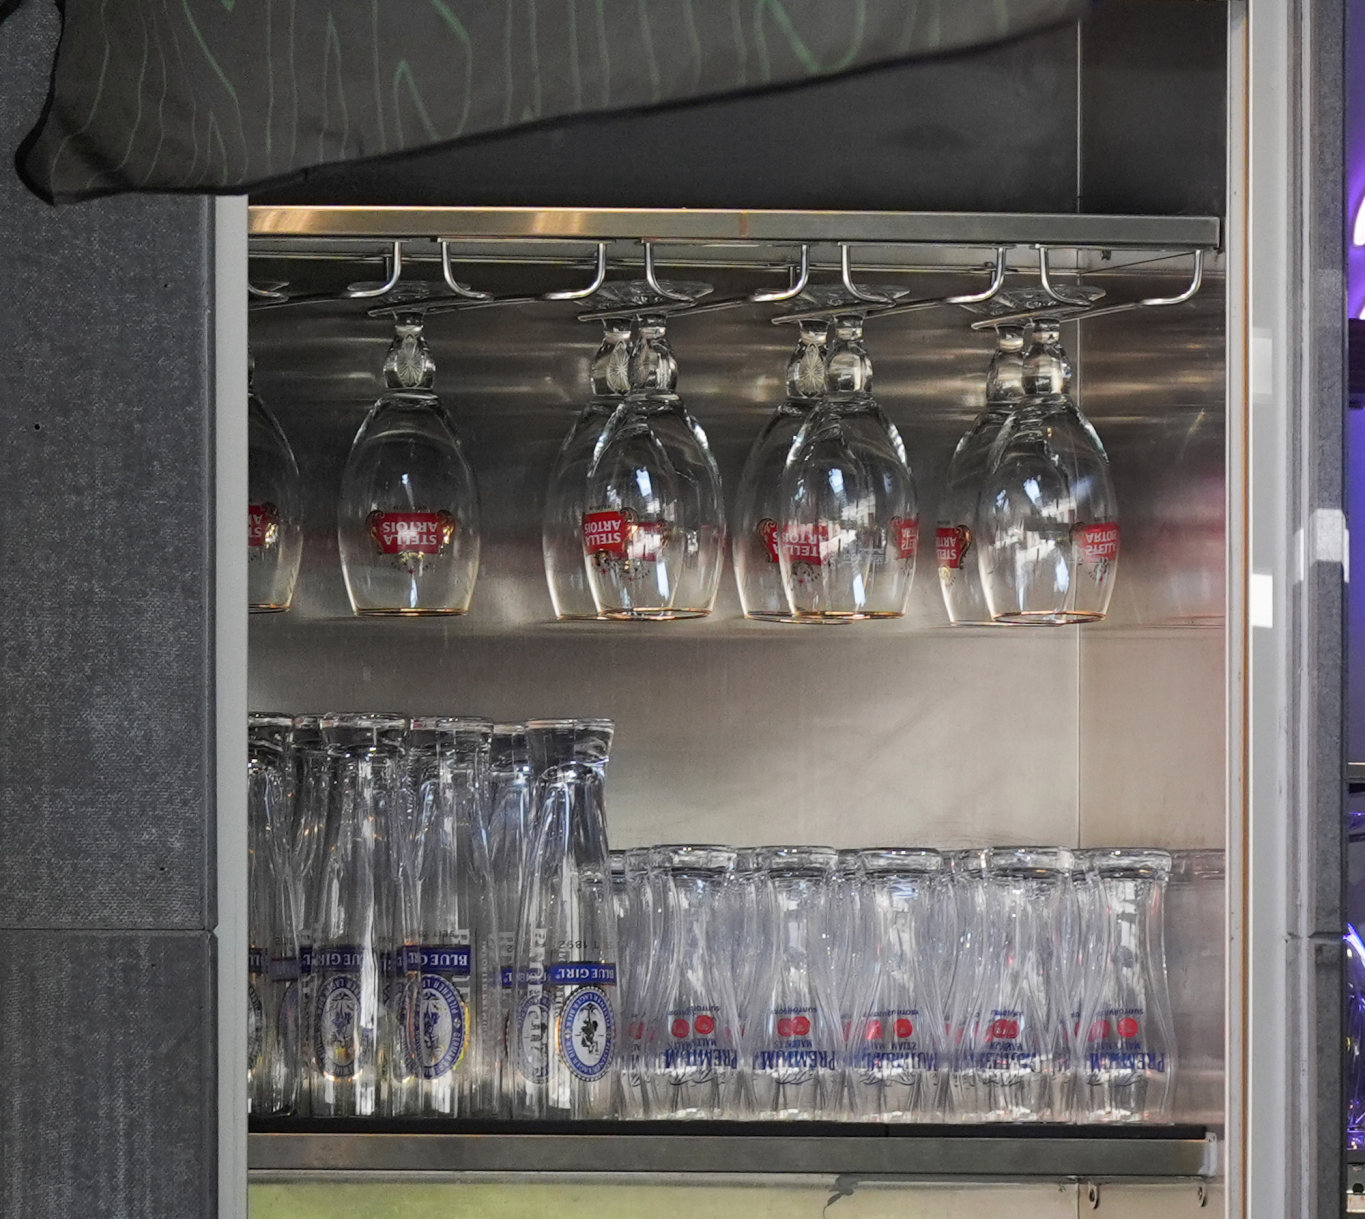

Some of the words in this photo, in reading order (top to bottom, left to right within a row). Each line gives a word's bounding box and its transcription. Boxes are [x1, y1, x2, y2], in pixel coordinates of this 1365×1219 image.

[383, 521, 438, 533] ARTOIS
[384, 534, 438, 545] STELLA
[558, 967, 592, 980] GIRL
